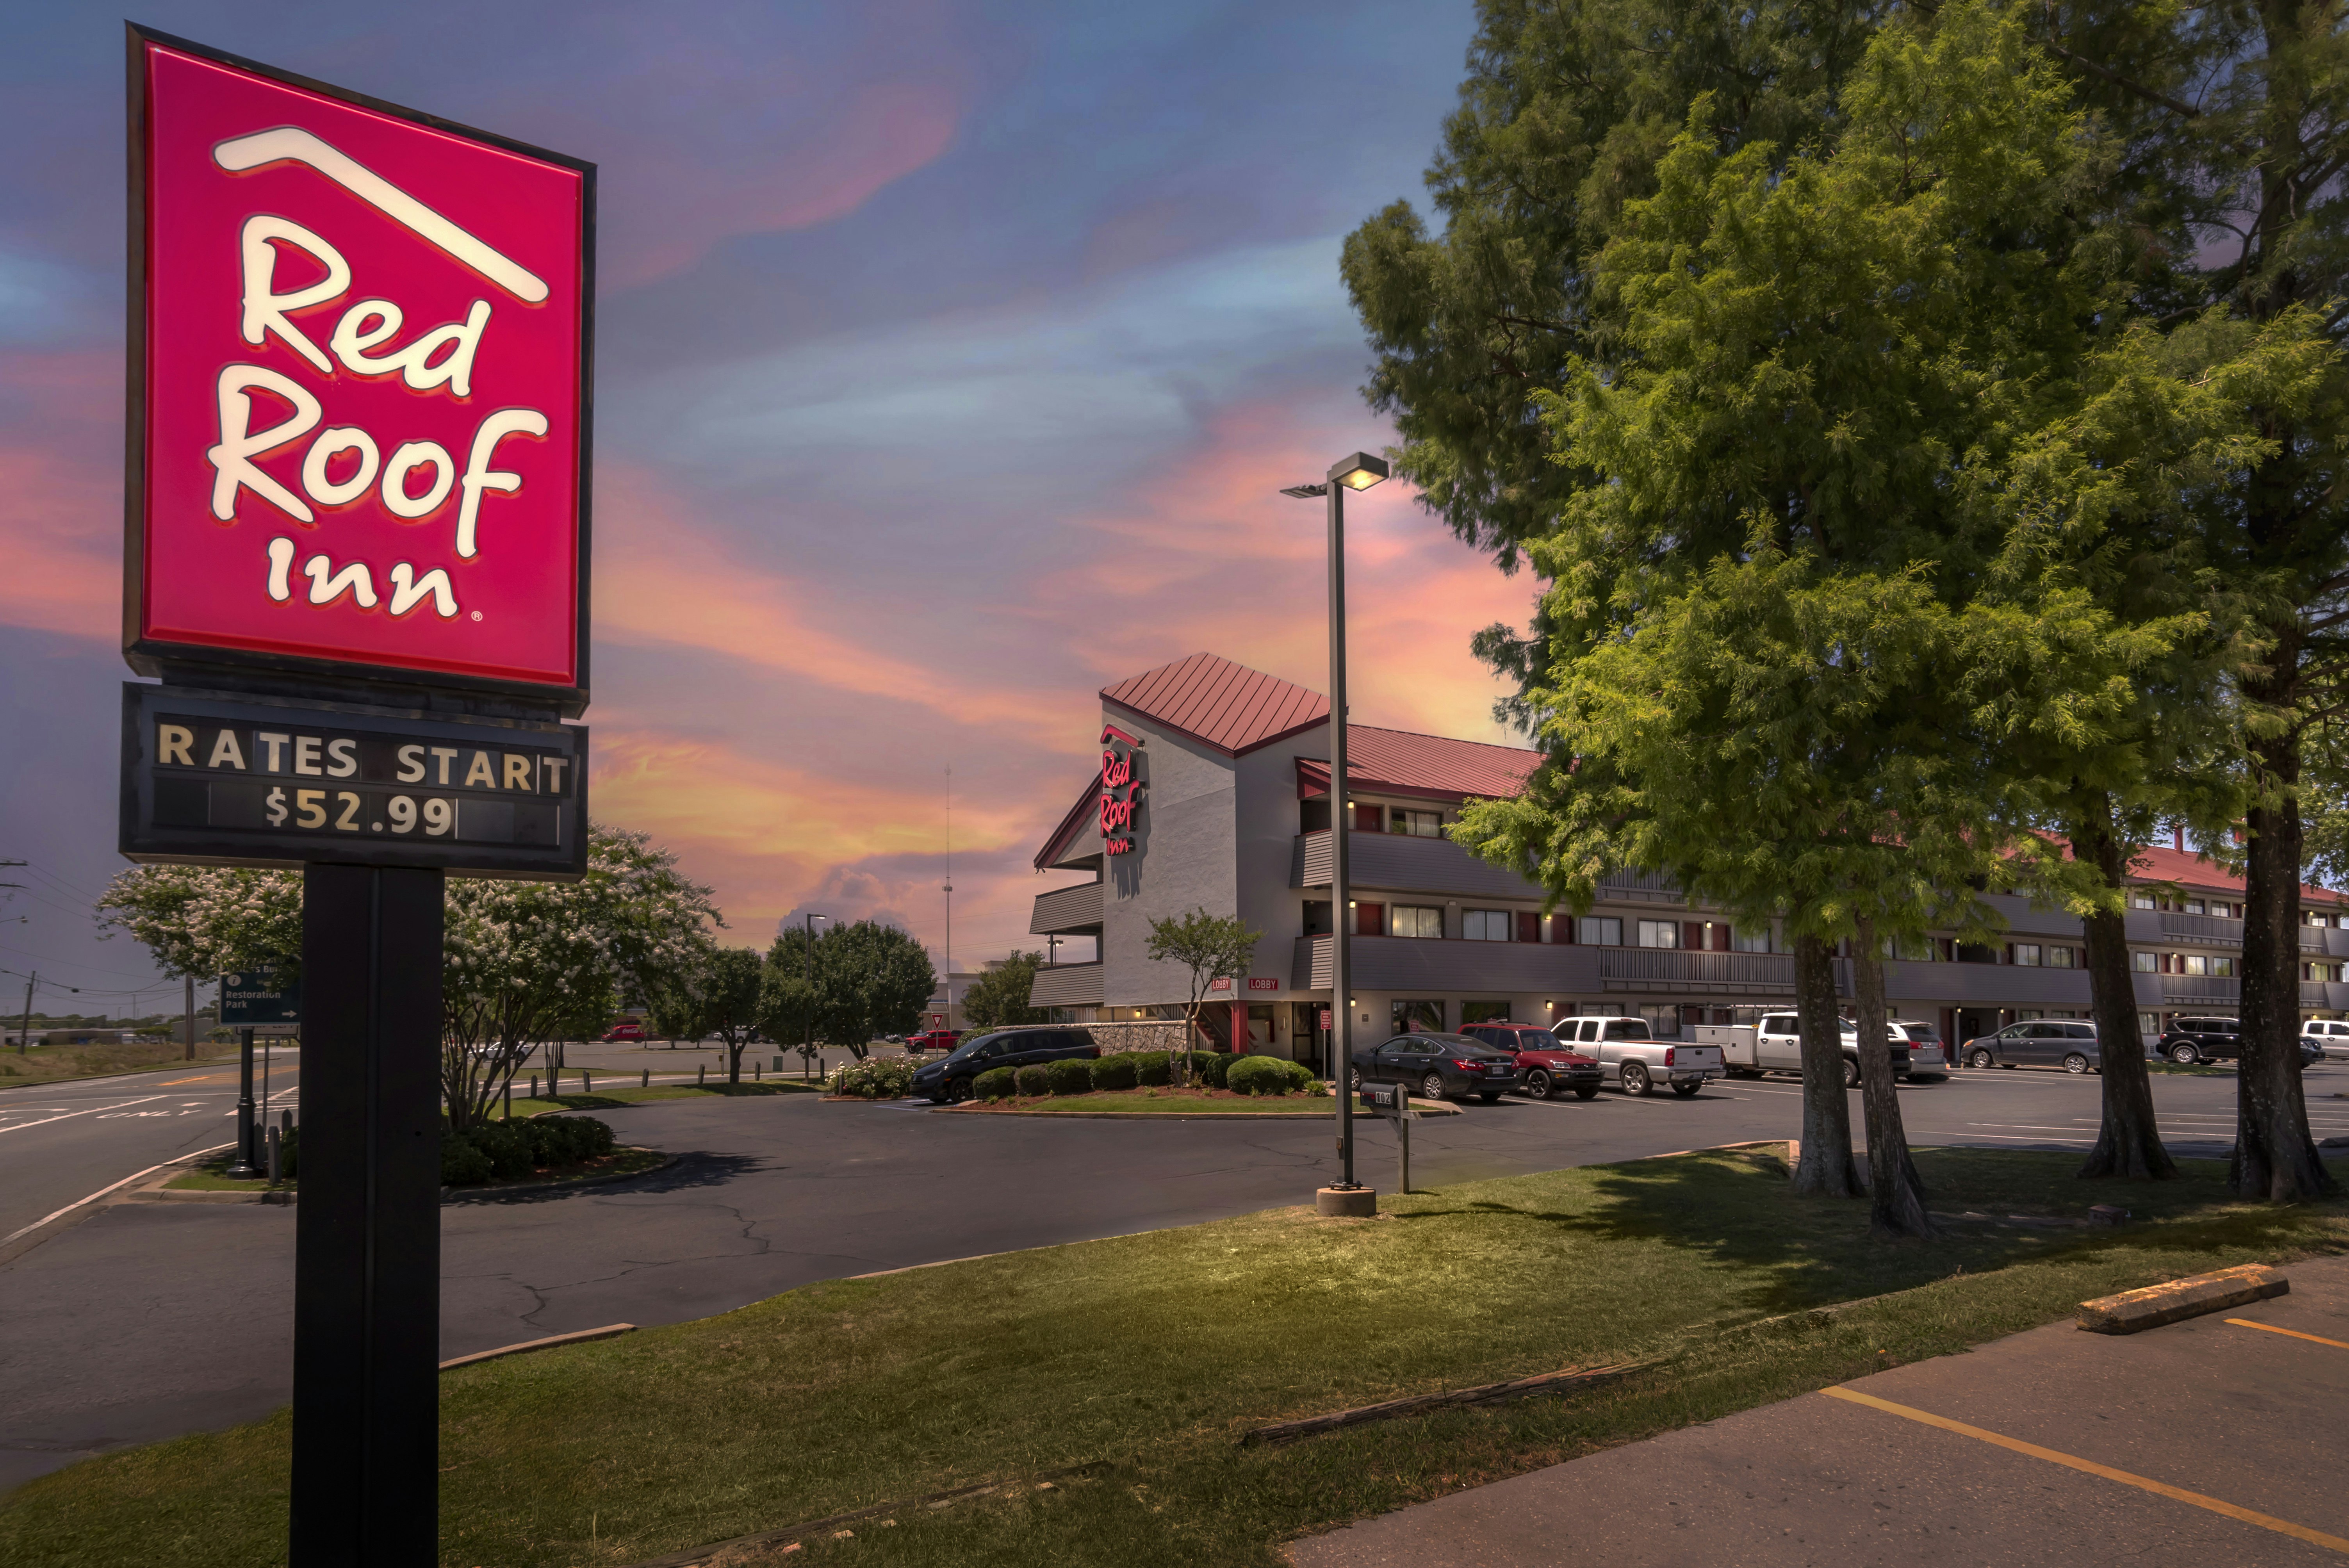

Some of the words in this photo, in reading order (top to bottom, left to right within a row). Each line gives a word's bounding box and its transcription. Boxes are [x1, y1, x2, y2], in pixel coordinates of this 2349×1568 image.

[241, 214, 492, 397] Red
[207, 363, 549, 559] Roof
[159, 724, 357, 777] RATES
[397, 744, 569, 793] START
[1103, 750, 1132, 789] Red
[266, 786, 452, 836] $52.99
[1100, 780, 1140, 838] Roof
[226, 991, 281, 999] Restoration
[1213, 979, 1229, 989] LOBBY
[1251, 980, 1276, 989] LOBBY
[226, 1000, 247, 1008] Park
[1377, 1092, 1390, 1103] 102
[95, 1110, 202, 1119] ONLY
